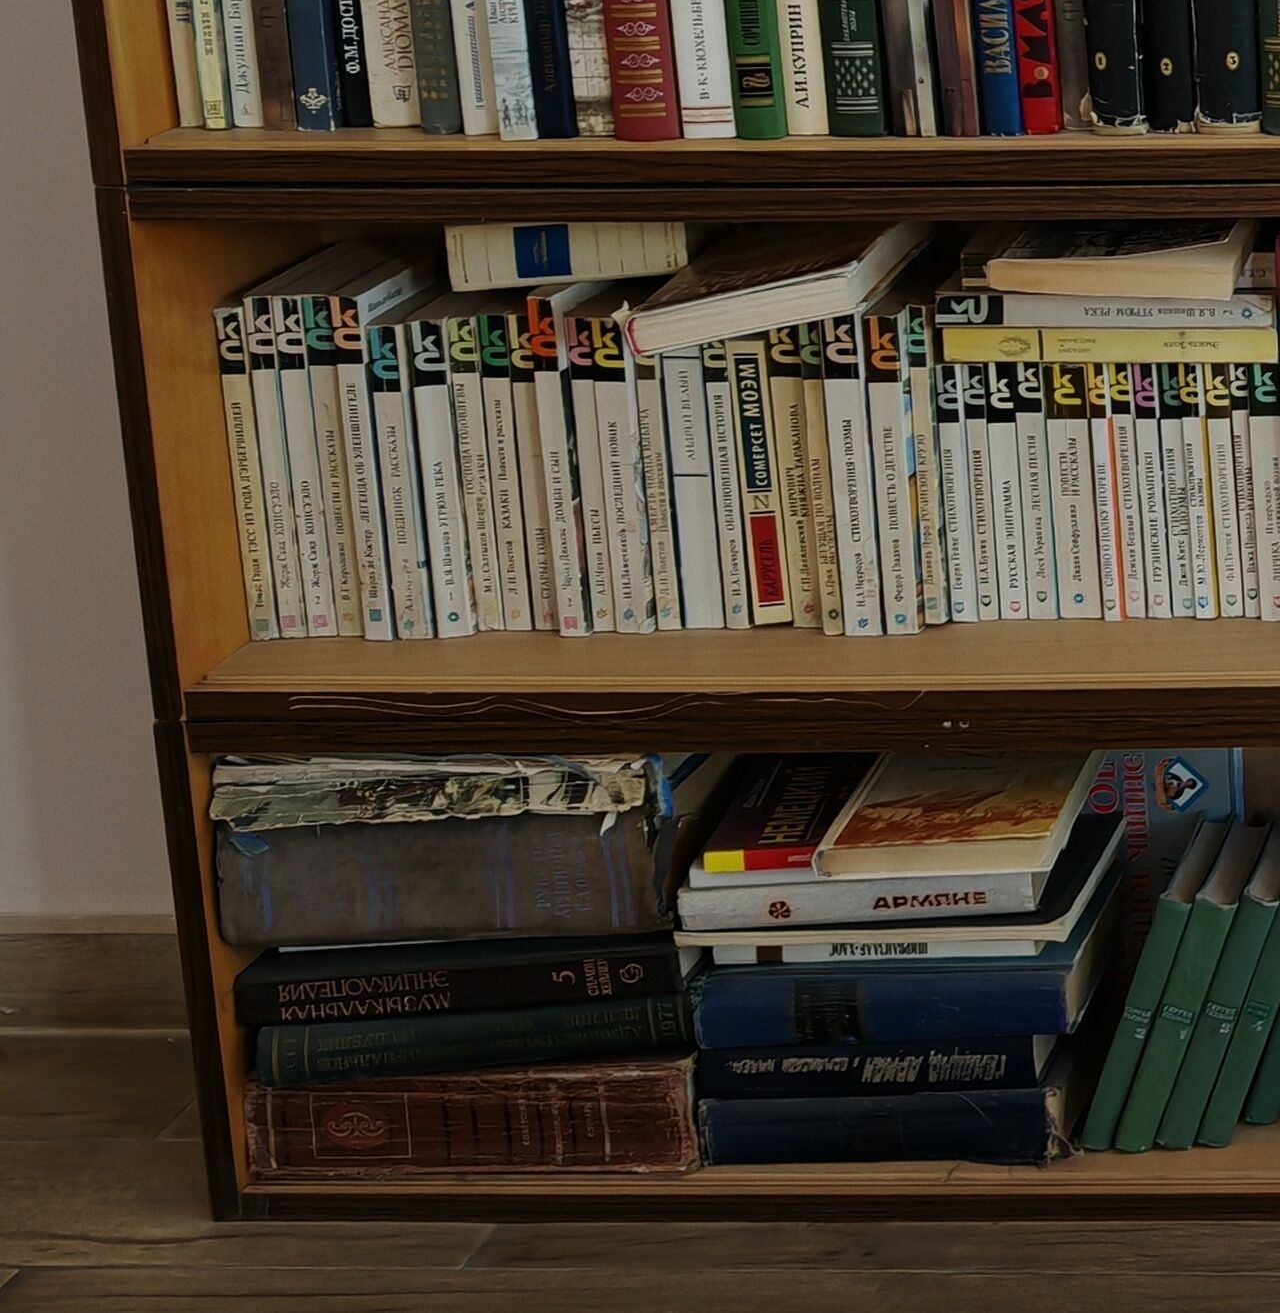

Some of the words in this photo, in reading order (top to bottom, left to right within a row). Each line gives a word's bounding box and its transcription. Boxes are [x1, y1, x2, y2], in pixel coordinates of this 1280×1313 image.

[234, 26, 250, 95] Джулиан
[787, 4, 810, 109] А.И.КУПРИН
[738, 363, 759, 418] МОЭМ
[431, 461, 446, 488] РЕКА
[749, 423, 769, 486] СОМЕРСЕТ
[886, 484, 901, 531] ПОВЕСТЬ
[872, 890, 987, 912] АРМЯНЕ
[278, 970, 450, 1003] ЭНЦИКЛОПЕДИЯ
[281, 991, 451, 1021] МУЗЫКАЛЬНАЯ
